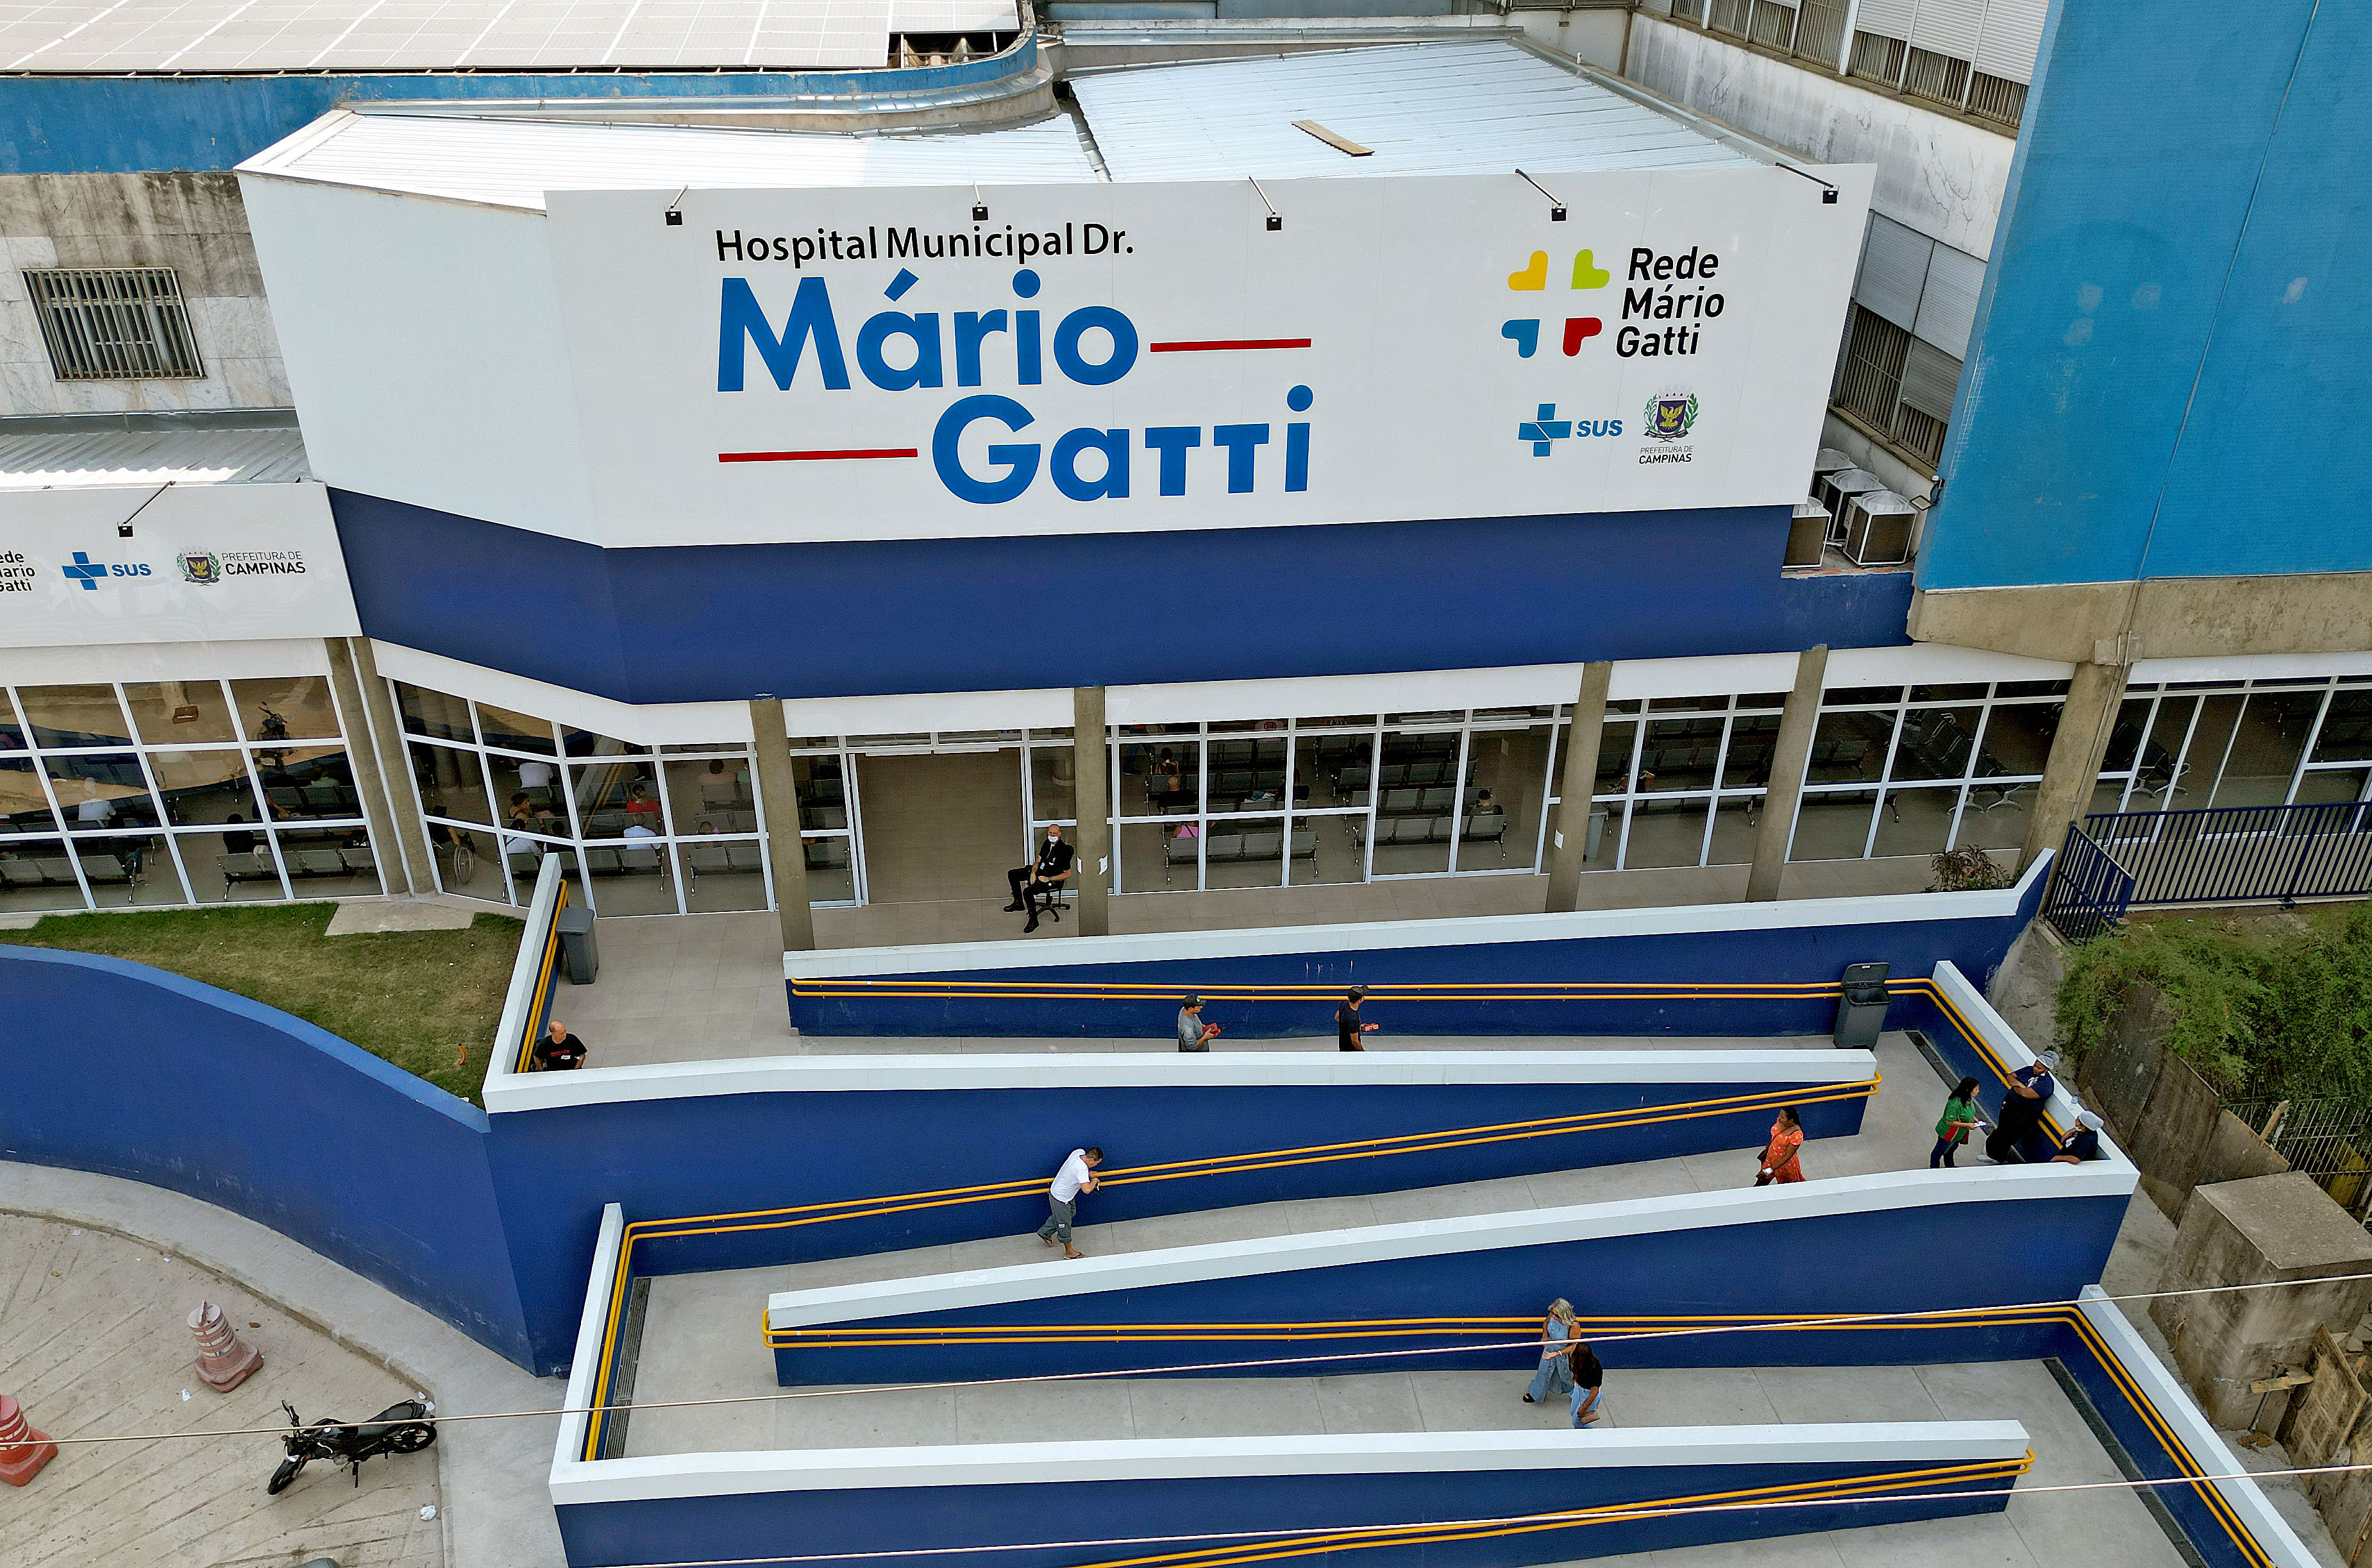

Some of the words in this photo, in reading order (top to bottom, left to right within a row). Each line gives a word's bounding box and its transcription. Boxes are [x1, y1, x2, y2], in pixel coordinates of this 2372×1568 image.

[716, 226, 877, 269] Hospital
[887, 223, 1073, 266] Municipal
[1083, 224, 1134, 255] Dr.
[1628, 246, 1719, 281] Rede
[1621, 283, 1725, 320] Mário
[718, 267, 1139, 392] Mário
[1616, 323, 1701, 358] Gatti
[1576, 420, 1623, 437] SUS
[1640, 446, 1683, 454] PREFEITURA
[1638, 453, 1692, 464] CAMPINAS
[221, 552, 287, 561] PREFEITURA
[287, 551, 303, 560] DE
[0, 564, 35, 578] ario
[112, 563, 152, 577] SUS
[225, 562, 307, 575] CAMPINAS
